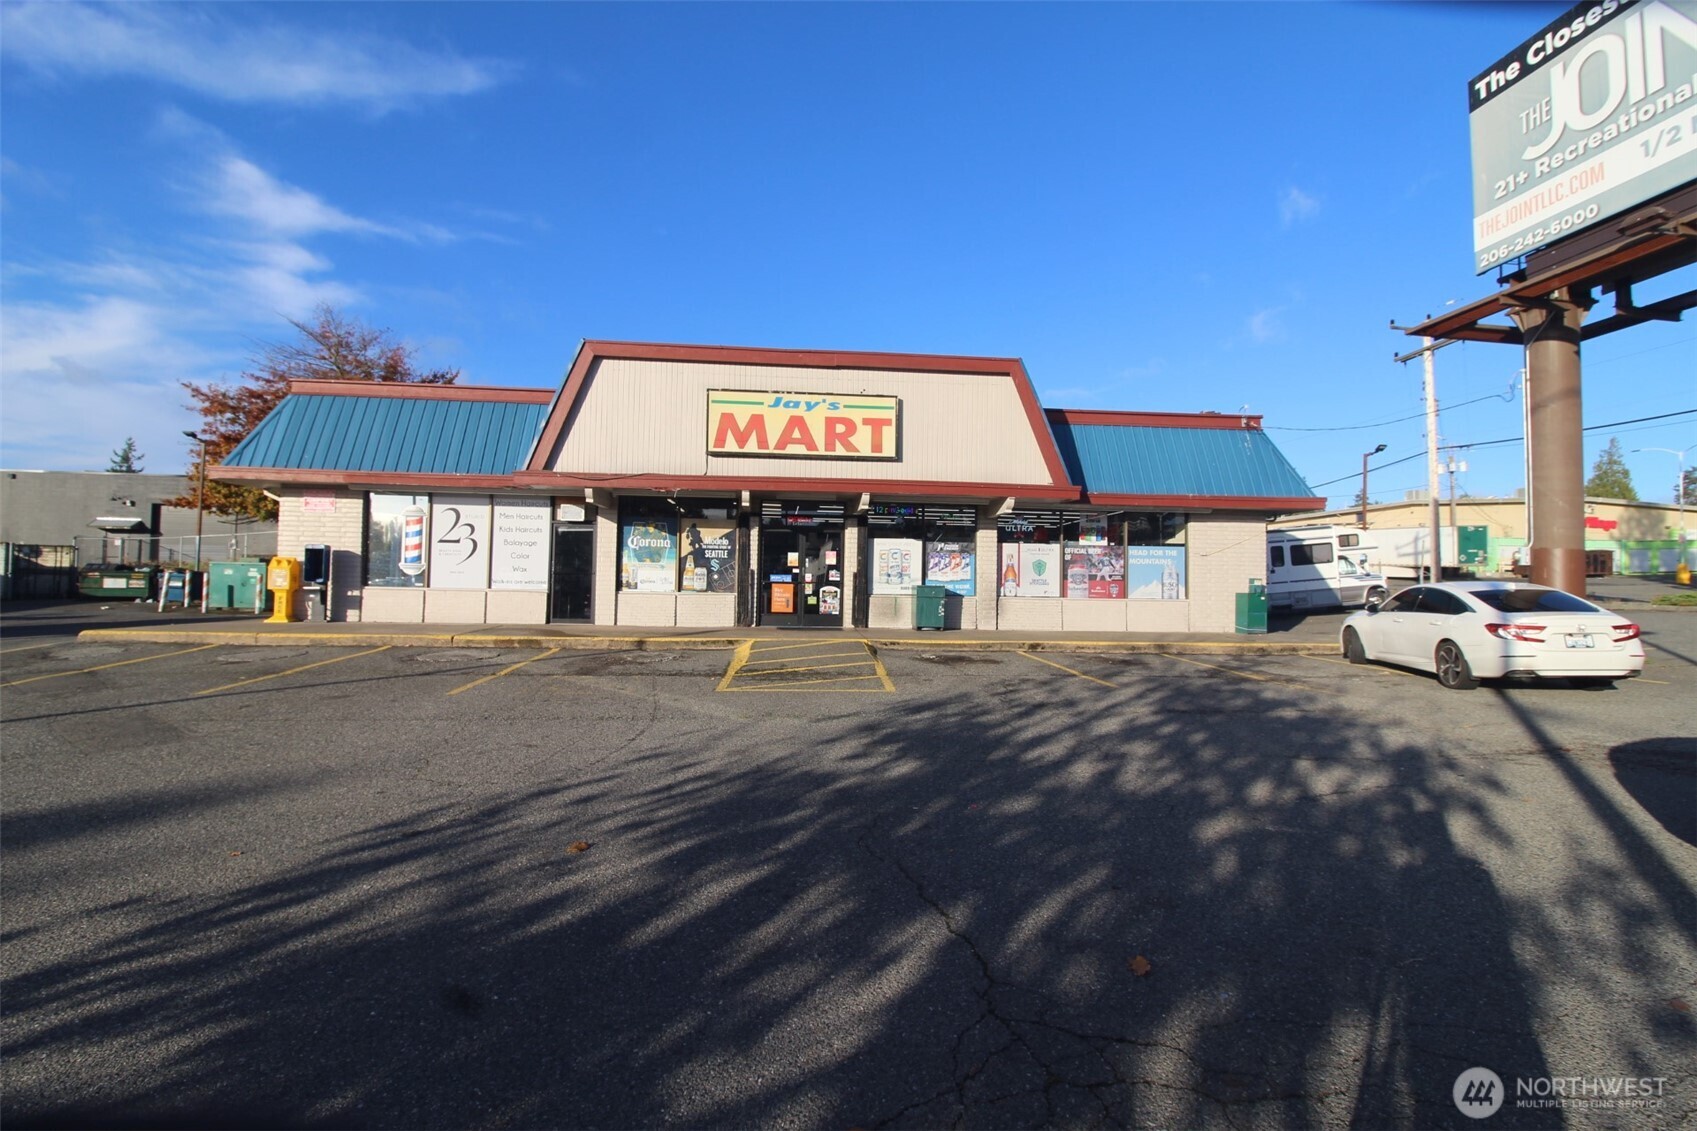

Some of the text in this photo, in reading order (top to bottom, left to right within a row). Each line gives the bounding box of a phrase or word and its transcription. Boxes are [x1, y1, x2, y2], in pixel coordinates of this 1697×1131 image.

[1475, 0, 1630, 100] The Closes
[1519, 96, 1552, 135] THE
[1494, 73, 1697, 200] 21+ Recreational
[1640, 125, 1682, 158] 1/2
[1478, 162, 1606, 239] THEJOINTLLC.COM
[1479, 204, 1599, 268] 206-242-6000
[767, 396, 841, 412] Jay's
[713, 412, 893, 454] MART
[437, 507, 478, 566] 23
[504, 539, 538, 547] Balayage
[627, 535, 671, 550] Corona
[703, 536, 729, 545] Modelo
[704, 550, 729, 558] SEATTLE
